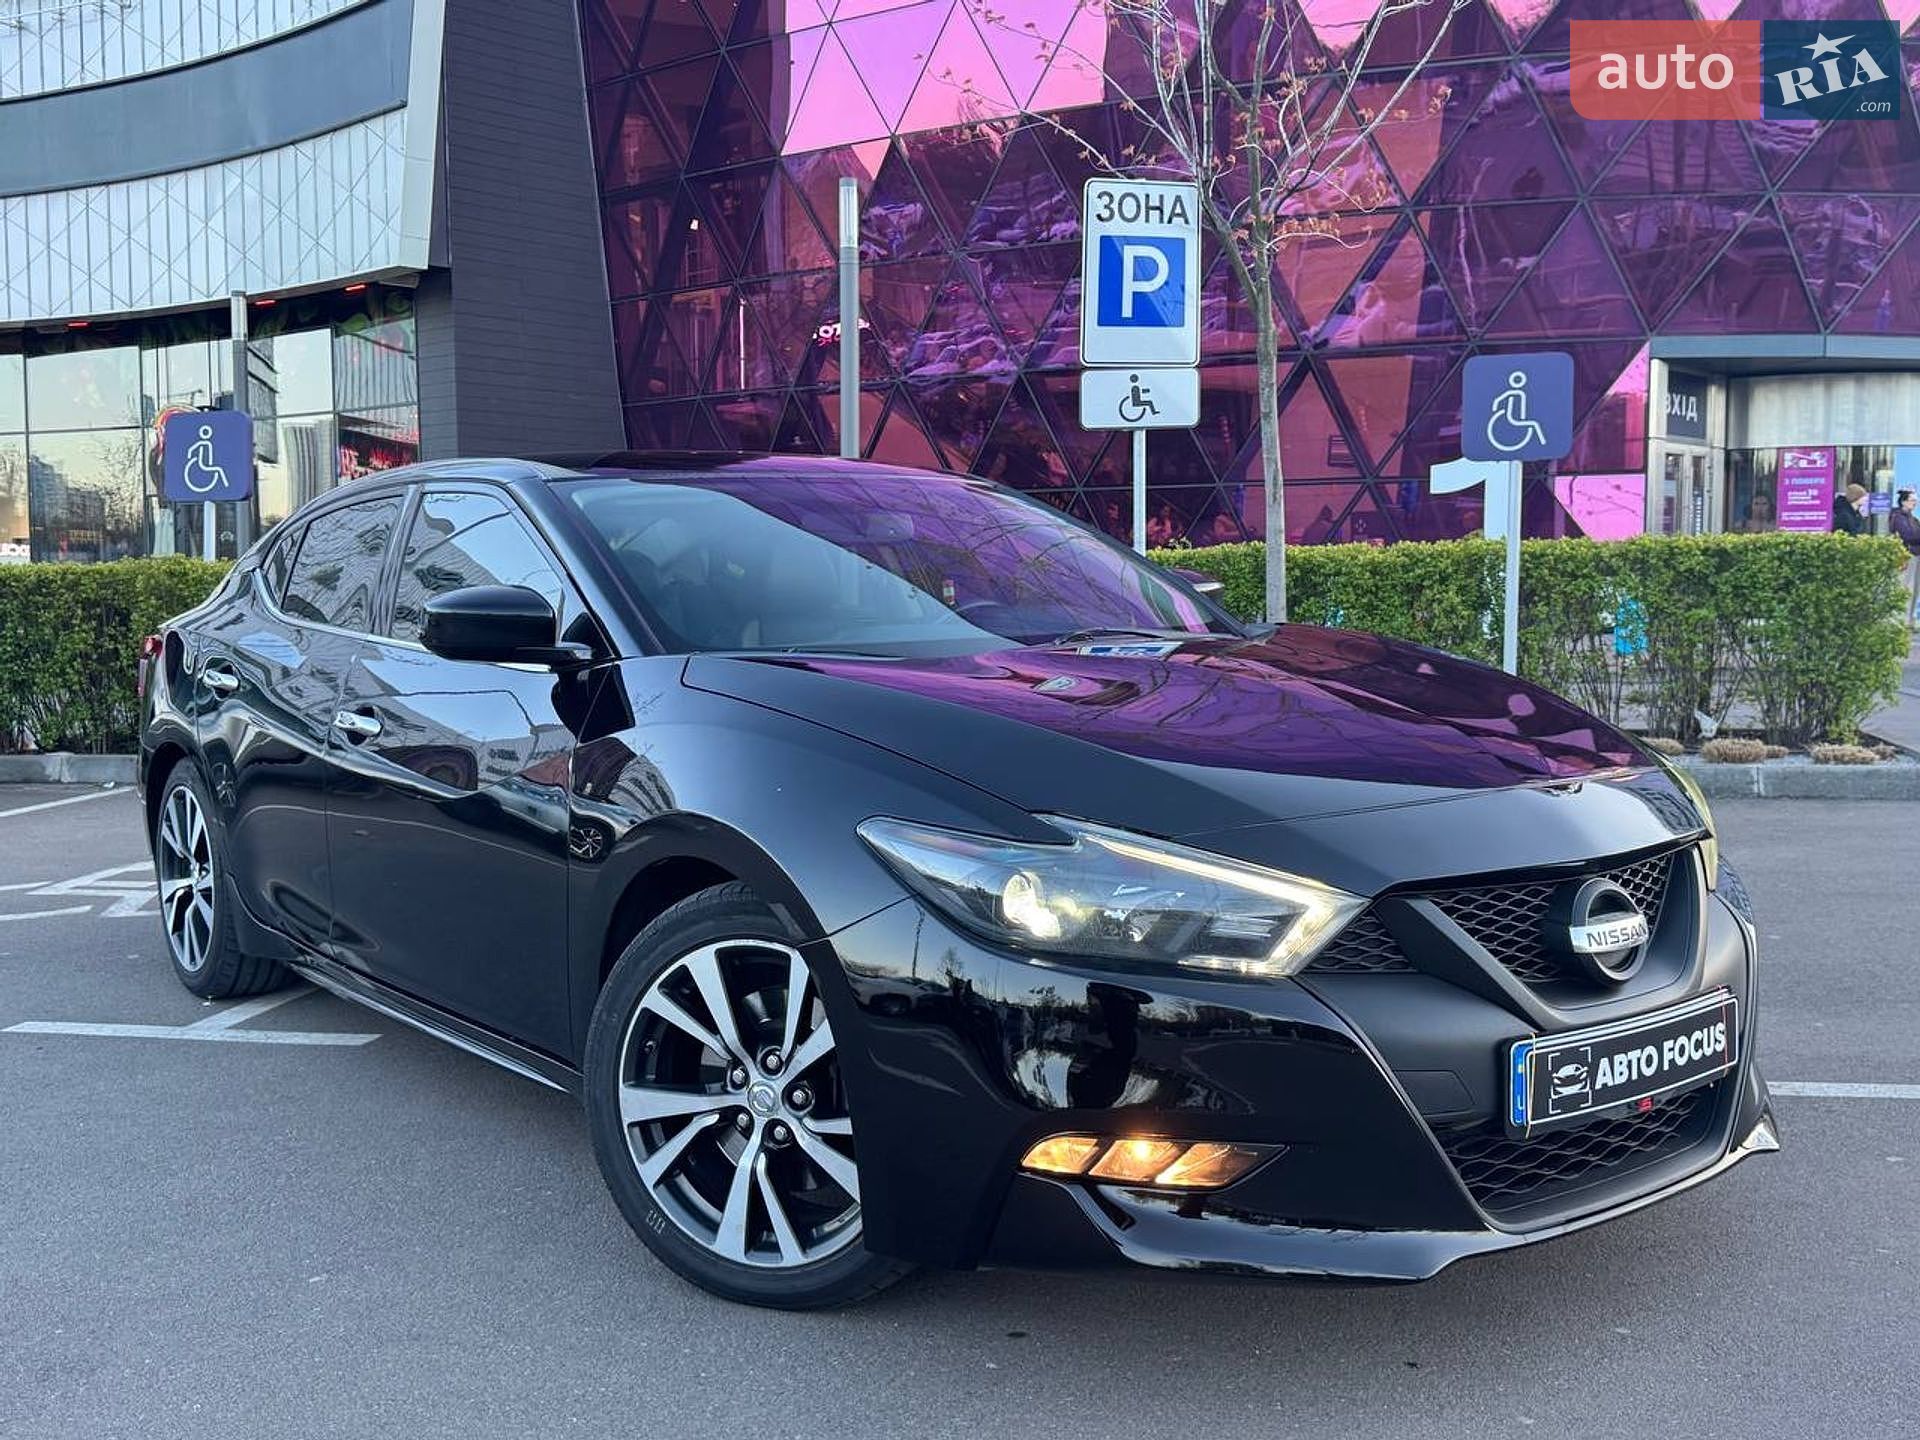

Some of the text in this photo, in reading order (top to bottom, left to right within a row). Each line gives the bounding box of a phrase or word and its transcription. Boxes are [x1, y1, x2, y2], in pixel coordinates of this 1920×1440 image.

[1096, 190, 1190, 225] ЗОНА
[1121, 244, 1169, 318] P
[1586, 922, 1648, 948] NISSAN
[1663, 1022, 1727, 1071] FOCUS
